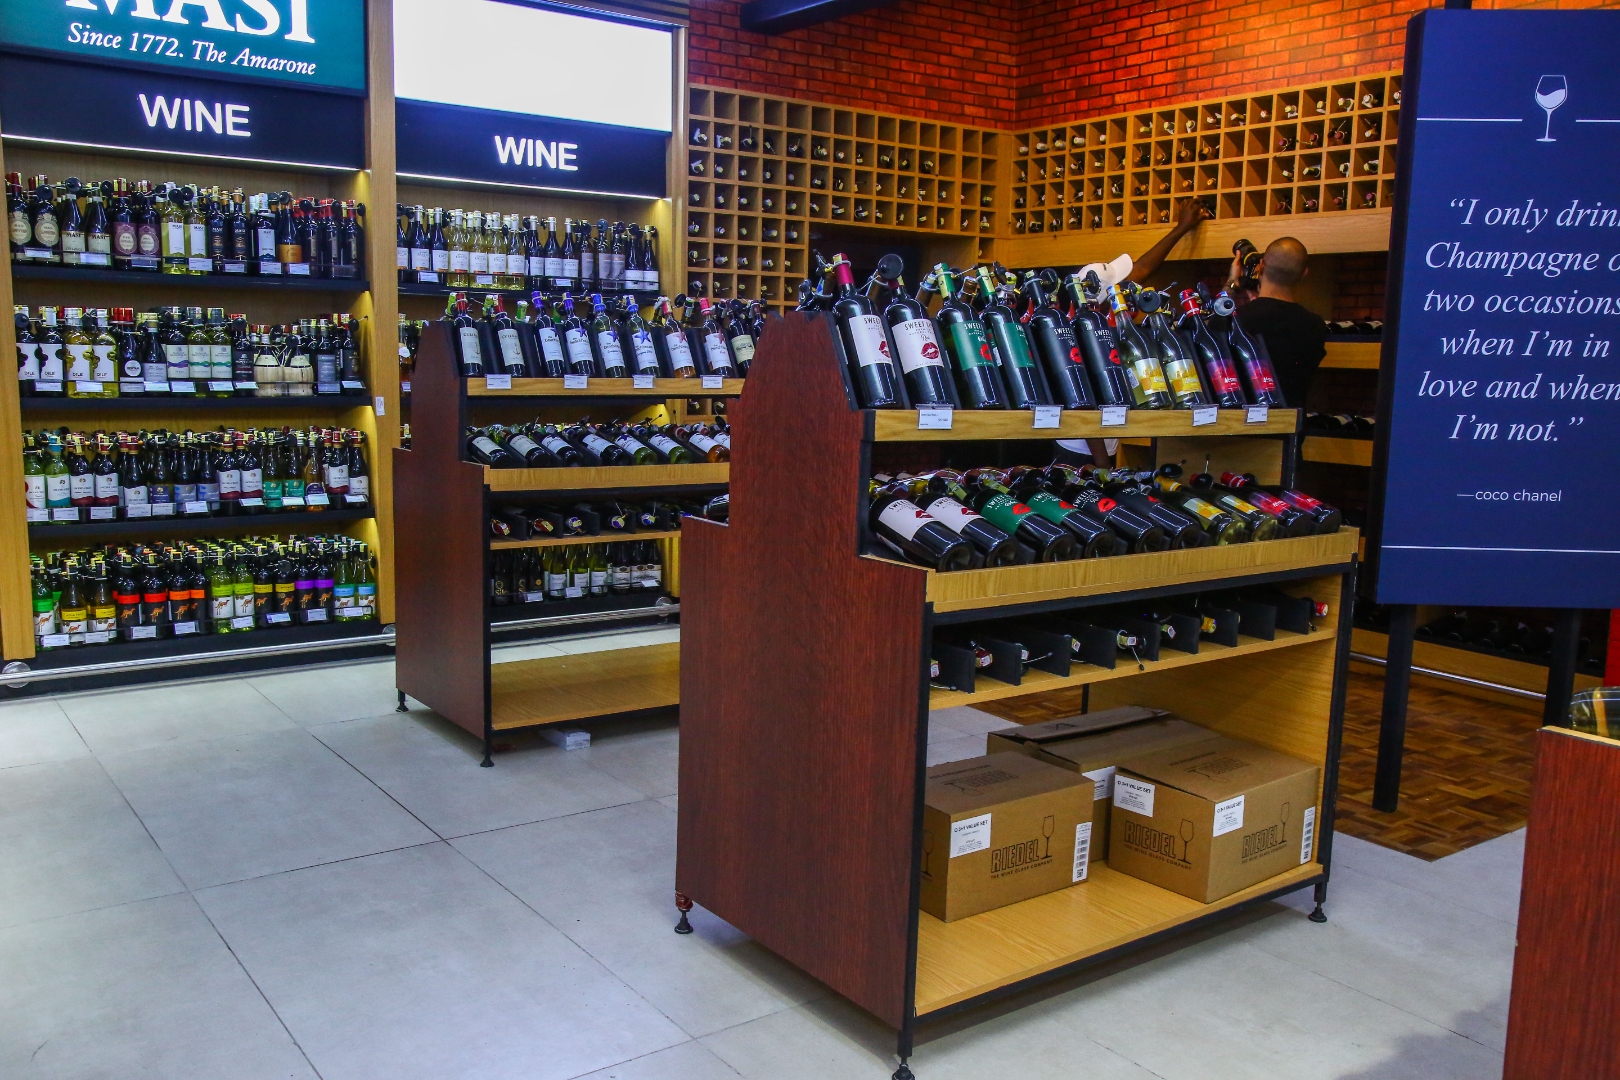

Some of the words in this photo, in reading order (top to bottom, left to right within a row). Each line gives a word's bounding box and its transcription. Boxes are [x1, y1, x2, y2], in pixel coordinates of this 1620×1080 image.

[67, 22, 122, 49] Since
[129, 32, 184, 57] 1772.
[192, 40, 227, 63] The
[230, 48, 316, 75] Amarone
[138, 93, 251, 137] WINE
[494, 135, 579, 172] WINE
[1485, 199, 1549, 233] only
[1556, 199, 1620, 226] drin
[1425, 241, 1600, 278] Champagne
[1423, 289, 1475, 312] two
[1484, 289, 1620, 315] occasions
[904, 321, 925, 331] SWEET
[1440, 329, 1515, 356] when
[1521, 330, 1573, 357] I’m
[1582, 333, 1610, 358] in
[1418, 371, 1478, 398] love
[1485, 373, 1543, 399] and
[1548, 374, 1620, 401] when
[1448, 414, 1499, 440] I’m
[1513, 489, 1563, 502] chanel
[990, 838, 1040, 874] RIEDEL
[1124, 820, 1176, 860] RIEDEL
[1242, 824, 1278, 859] RIEDEL
[1001, 869, 1014, 877] WINE
[1031, 859, 1053, 869] COMPANY
[1149, 851, 1165, 862] GLASS
[1166, 858, 1192, 871] COMPANY
